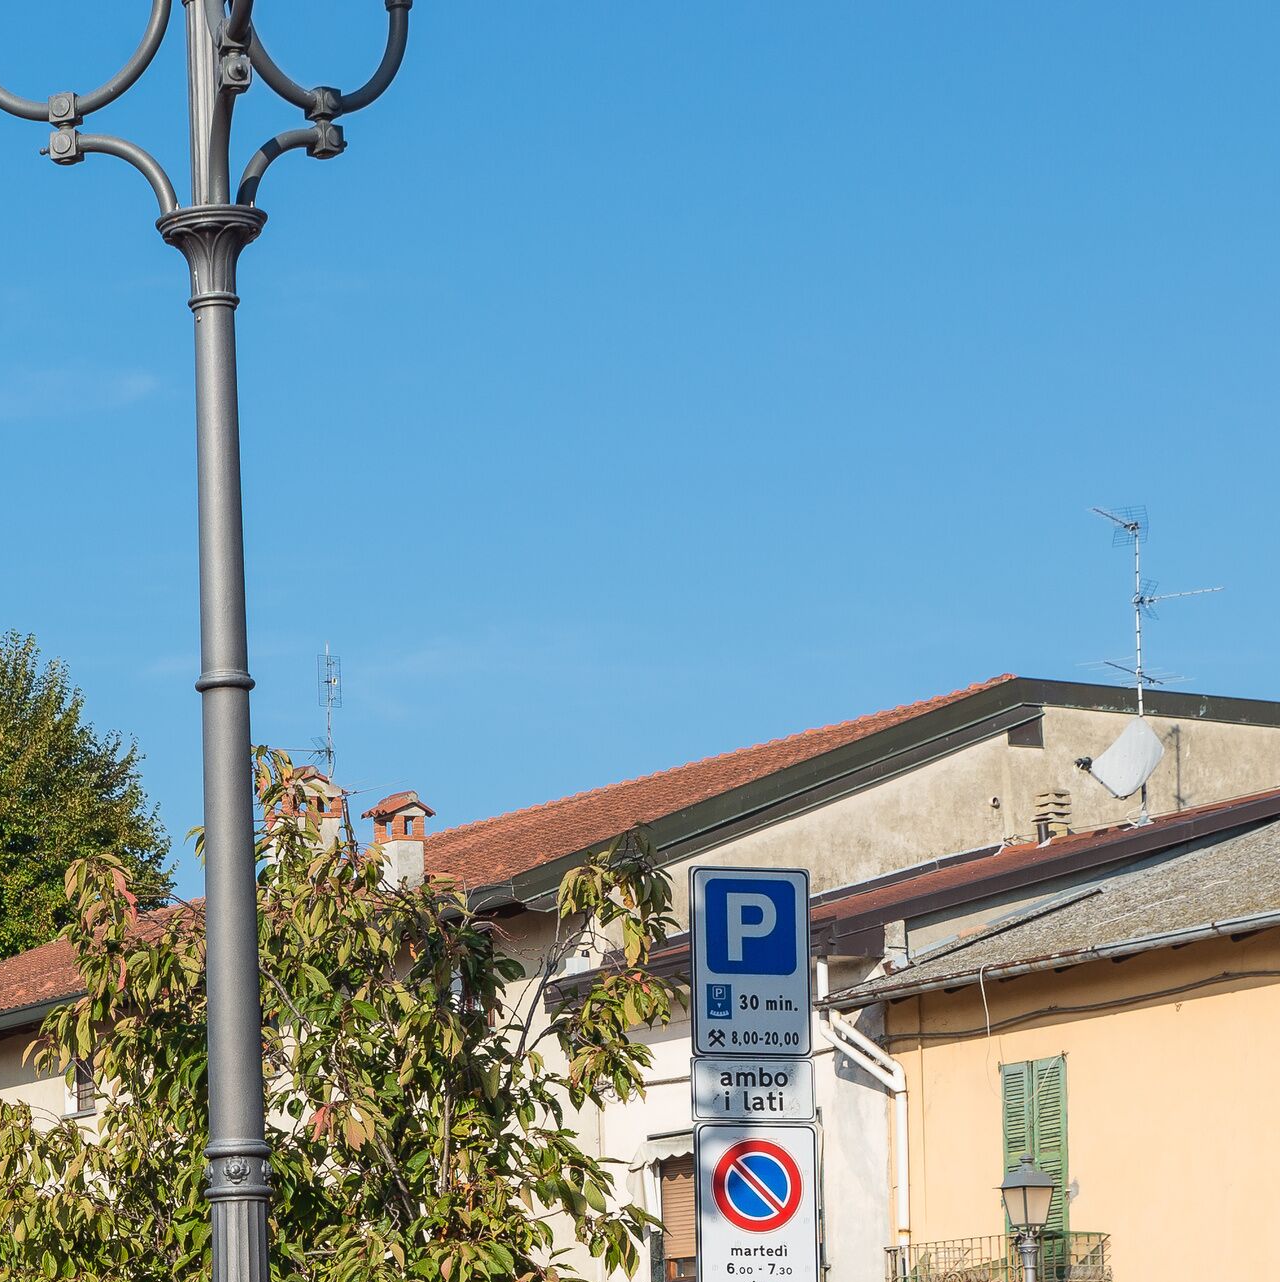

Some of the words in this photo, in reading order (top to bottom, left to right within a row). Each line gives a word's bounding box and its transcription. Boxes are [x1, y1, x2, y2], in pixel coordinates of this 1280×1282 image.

[726, 892, 777, 962] P
[715, 987, 723, 998] P
[739, 994, 760, 1011] 30
[765, 994, 799, 1012] min.
[720, 1066, 789, 1088] ambo
[724, 1090, 730, 1111] i
[743, 1090, 784, 1112] lati
[730, 1244, 788, 1257] martedì
